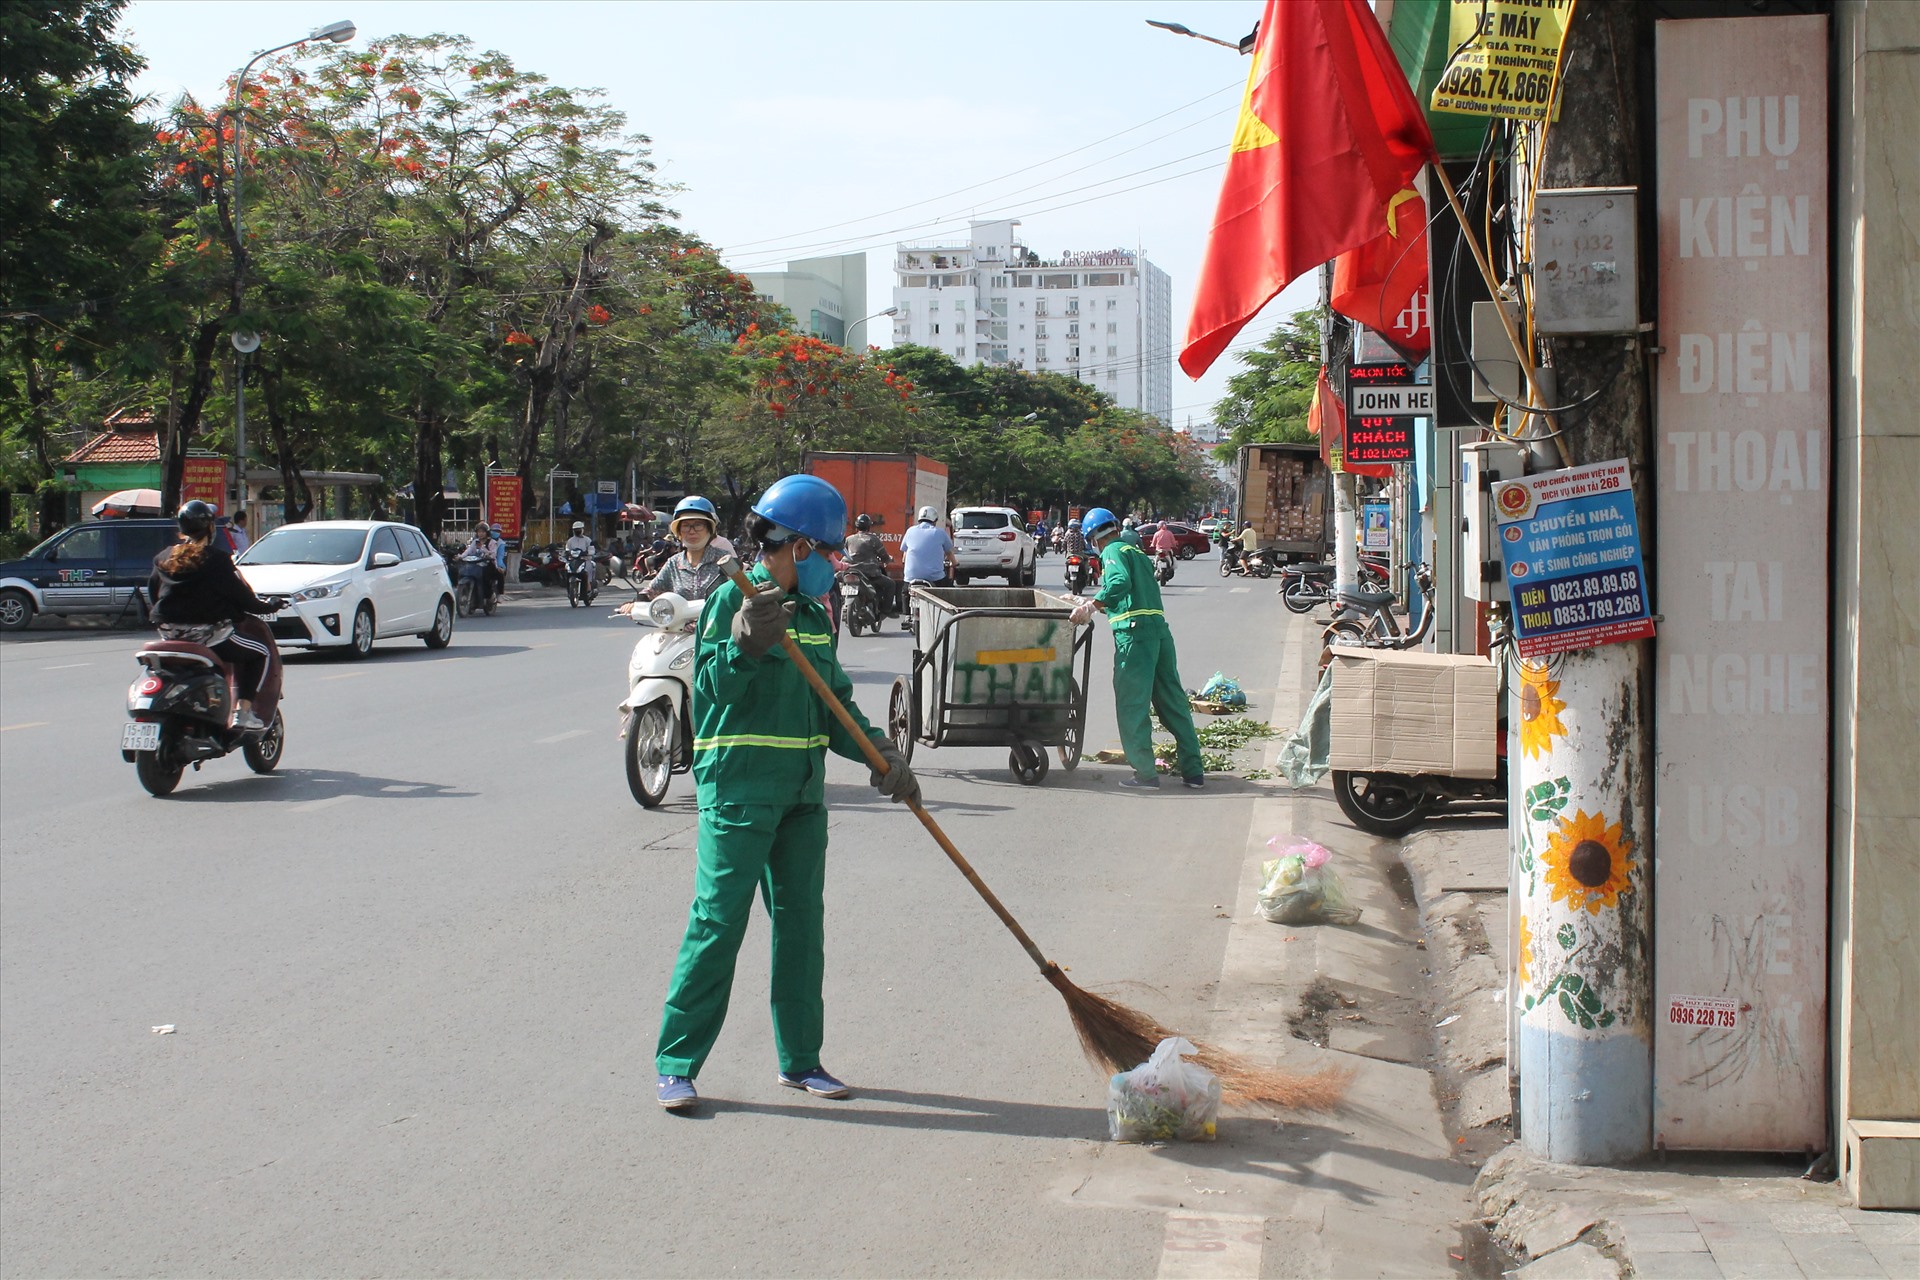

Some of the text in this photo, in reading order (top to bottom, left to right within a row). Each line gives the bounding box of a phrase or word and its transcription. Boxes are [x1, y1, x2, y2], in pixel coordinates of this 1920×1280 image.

[1475, 11, 1540, 40] XE MÁY
[1472, 54, 1484, 64] XE
[1487, 55, 1491, 64] 1
[1486, 40, 1509, 51] GIÁ
[1514, 44, 1536, 55] TRỊ
[1541, 48, 1558, 57] XE
[1534, 108, 1548, 118] SE
[1688, 96, 1799, 170] PHỤ
[1679, 183, 1810, 271] KIỆN
[1099, 258, 1134, 266] HOTEL
[1350, 364, 1406, 378] SALON TÓC
[1678, 320, 1810, 407] ĐIỆN
[1358, 393, 1400, 409] JOHN
[1352, 430, 1406, 443] KHÁCH
[1362, 449, 1380, 459] 102
[1591, 468, 1605, 479] VIỆT
[1608, 466, 1624, 475] NAM
[1668, 429, 1820, 504] THOẠI
[1542, 491, 1558, 501] DỊCH
[1560, 488, 1569, 497] VỤ
[1571, 485, 1585, 496] VẬN
[1600, 477, 1619, 489] 268
[1530, 510, 1586, 534] CHUYỂN
[1529, 522, 1633, 553] VĂN PHÒNG TRỌN GÓI
[1532, 545, 1635, 576] VỆ SINH CÔNG NGHIỆP
[58, 569, 94, 581] THP
[1521, 571, 1637, 608] ĐIỆN 0823.89.89.68
[1704, 561, 1783, 622] TAI
[1522, 594, 1640, 629] THOẠI 0853.789.268
[1668, 652, 1818, 714] NGHE
[1686, 784, 1798, 848] USB
[1670, 1007, 1735, 1027] 0936.228.735
